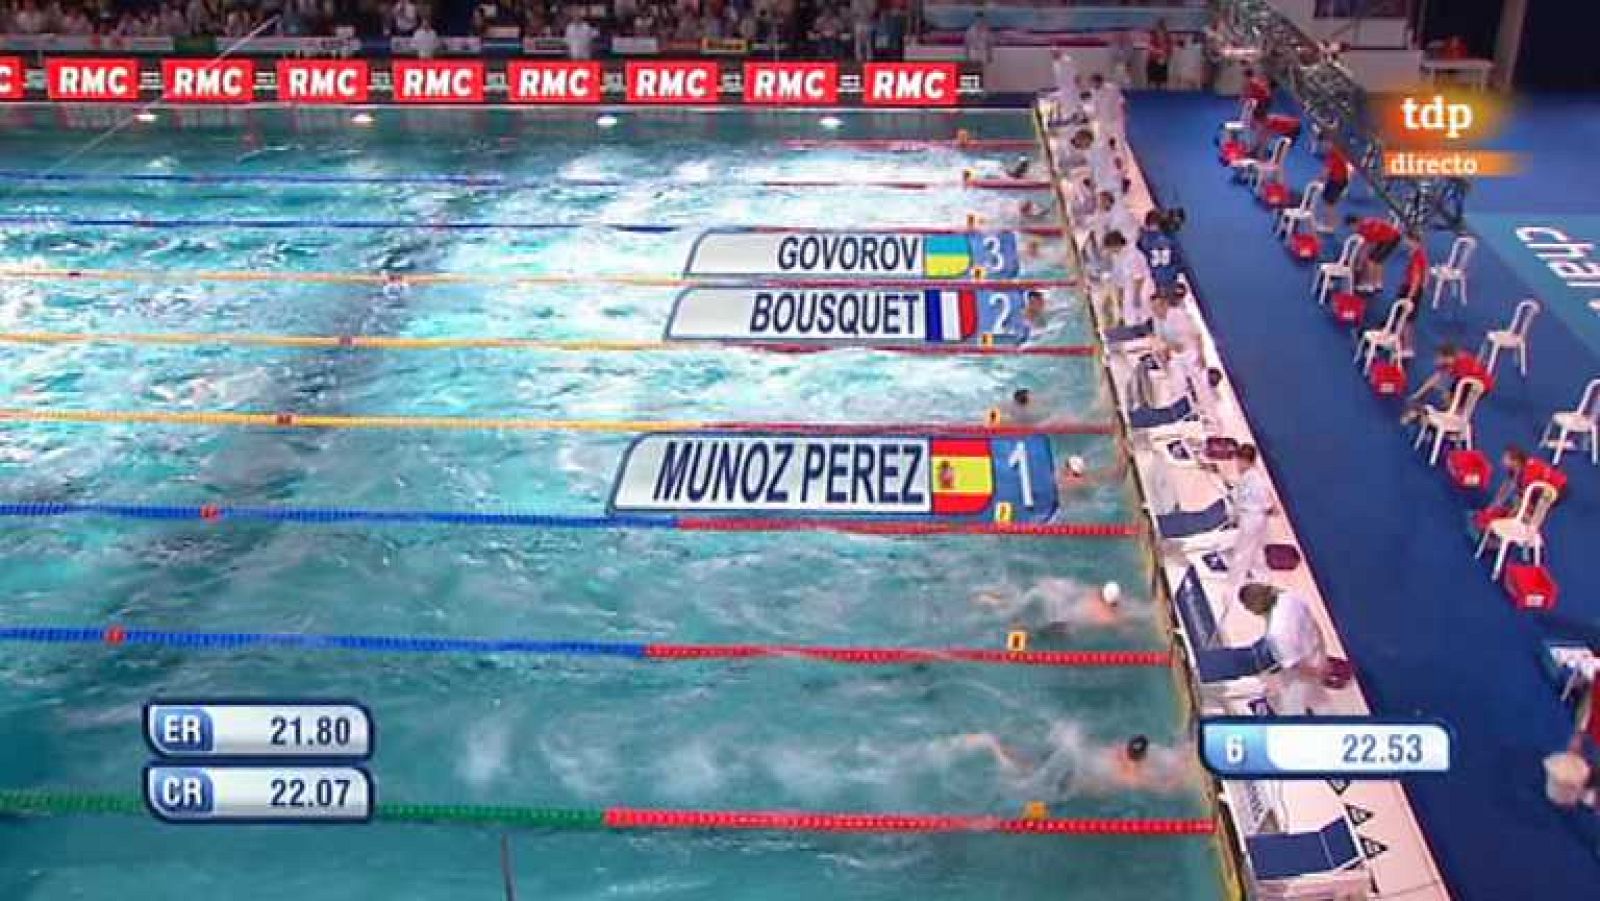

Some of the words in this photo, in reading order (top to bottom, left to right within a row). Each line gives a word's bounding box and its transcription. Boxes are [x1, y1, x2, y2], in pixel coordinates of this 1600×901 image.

[59, 66, 129, 94] RMC
[173, 67, 243, 95] RMC
[289, 68, 358, 96] RMC
[403, 68, 473, 96] RMC
[518, 68, 592, 97] RMC
[636, 68, 708, 97] RMC
[754, 69, 826, 97] RMC
[873, 70, 946, 98] RMC
